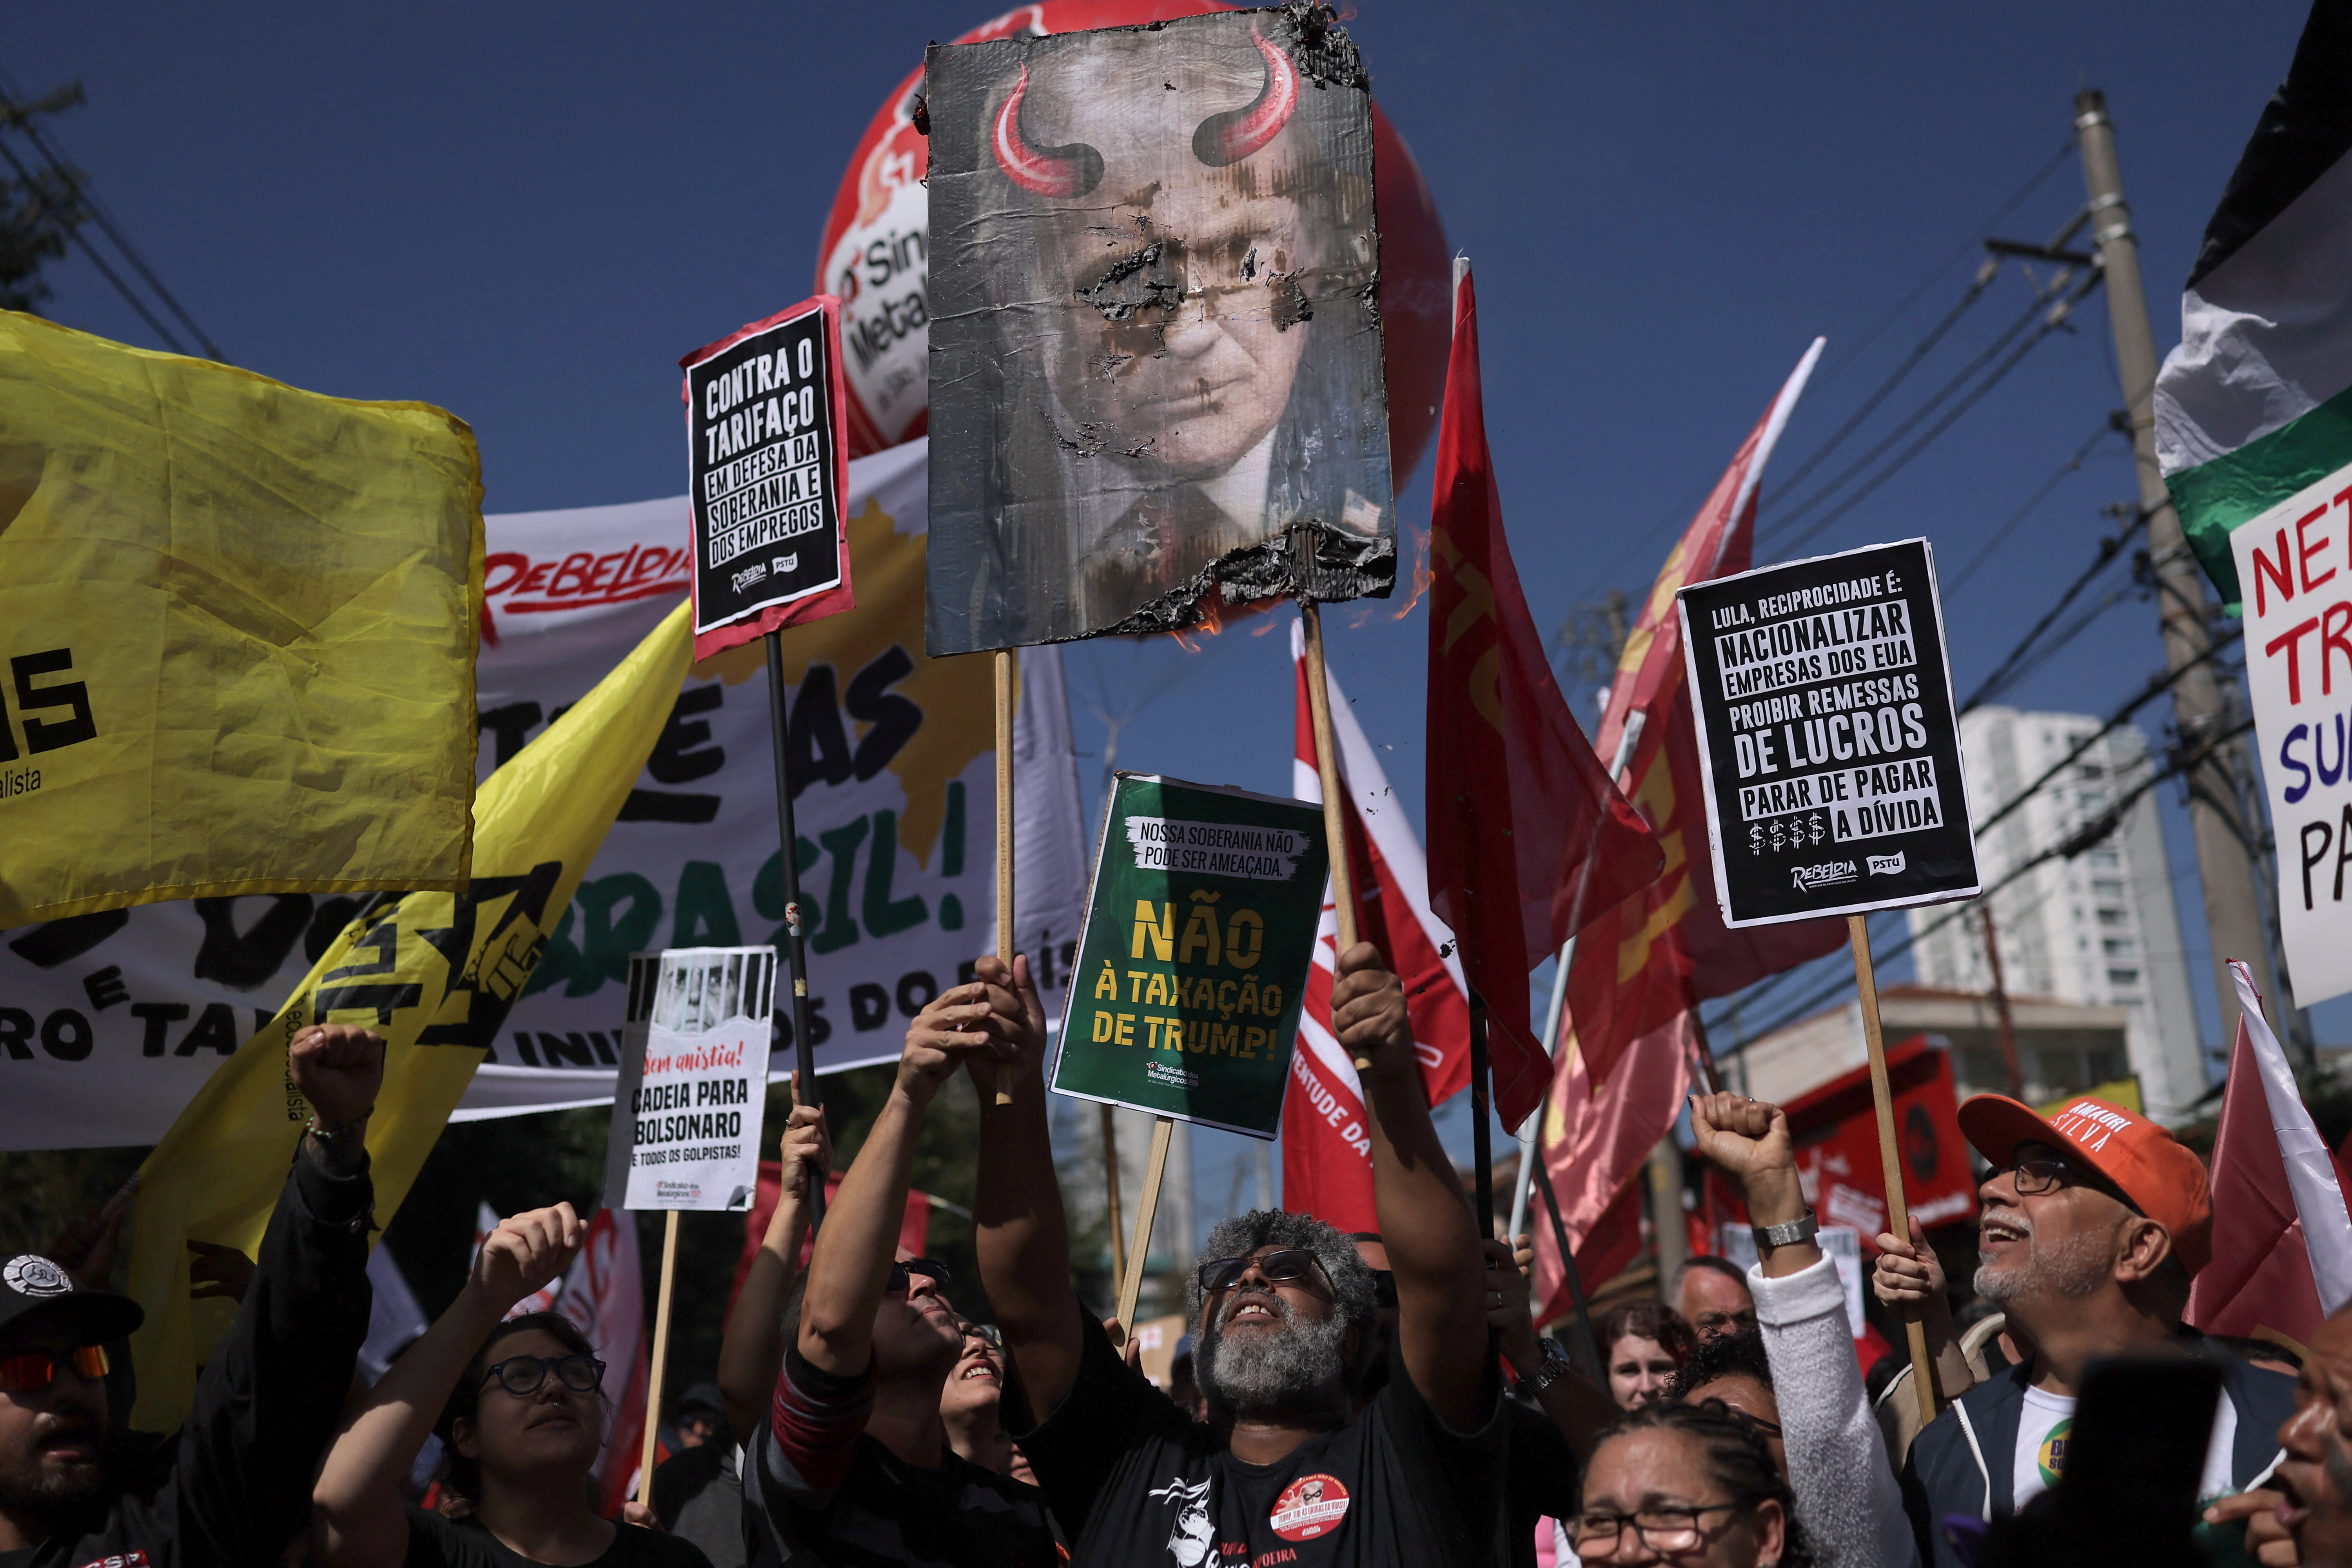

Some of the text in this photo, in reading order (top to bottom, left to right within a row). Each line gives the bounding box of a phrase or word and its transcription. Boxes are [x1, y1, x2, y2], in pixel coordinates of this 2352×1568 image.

[706, 338, 813, 420] CONTRA O
[706, 385, 814, 465] TARIFAÇO
[708, 434, 817, 499] EM DEFESA DA
[711, 466, 818, 533] SOBERANIA E
[712, 503, 820, 565] DOS EMPREGOS
[731, 559, 794, 595] REBELDIA PSTU
[1712, 570, 1902, 630] LULA, RECIPROCIDADE É:
[1720, 603, 1907, 669] NACIONALIZAR
[1725, 640, 1913, 697] EMPRESAS DOS EUA
[787, 644, 923, 799] AS
[1729, 673, 1919, 732] PROIBIR REMESSAS
[1734, 703, 1927, 779] DE LUCROS
[2280, 704, 2352, 804] SU
[1743, 760, 1934, 817] PARAR DE PAGAR
[1140, 822, 1293, 853] NOSSA SOBERANIA NÃO
[1837, 809, 1853, 839] A
[1857, 797, 1939, 836] DÍVIDA
[1145, 846, 1283, 878] PODE SER AMEAÇADA.
[1791, 858, 1900, 894] REBELDIA PSTU
[1131, 889, 1264, 969] NÃO
[83, 965, 130, 1010] E
[131, 1002, 275, 1057] TA
[849, 972, 938, 1031] DO
[1095, 960, 1282, 1020] À TAXAÇÃO
[643, 1041, 743, 1076] Sem anistia!
[1093, 1011, 1277, 1061] DE TRUMP!
[1147, 1070, 1188, 1085] Metalúrgicos
[1157, 1064, 1187, 1076] Sindicato
[632, 1078, 748, 1114] CADEIA PARA
[2069, 1102, 2132, 1133] AMAURI
[634, 1111, 740, 1145] BOLSONARO
[1340, 1121, 1371, 1157] DA
[2053, 1113, 2111, 1152] SILVA
[632, 1145, 740, 1166] E TODOS OS GOLPISTAS!
[1291, 1474, 1317, 1490] SOBERANIA
[1278, 1513, 1292, 1524] TRUMP,
[1308, 1504, 1324, 1515] GARRAS
[1331, 1500, 1348, 1510] BRASIL!
[1252, 1548, 1297, 1568] APOEIRA
